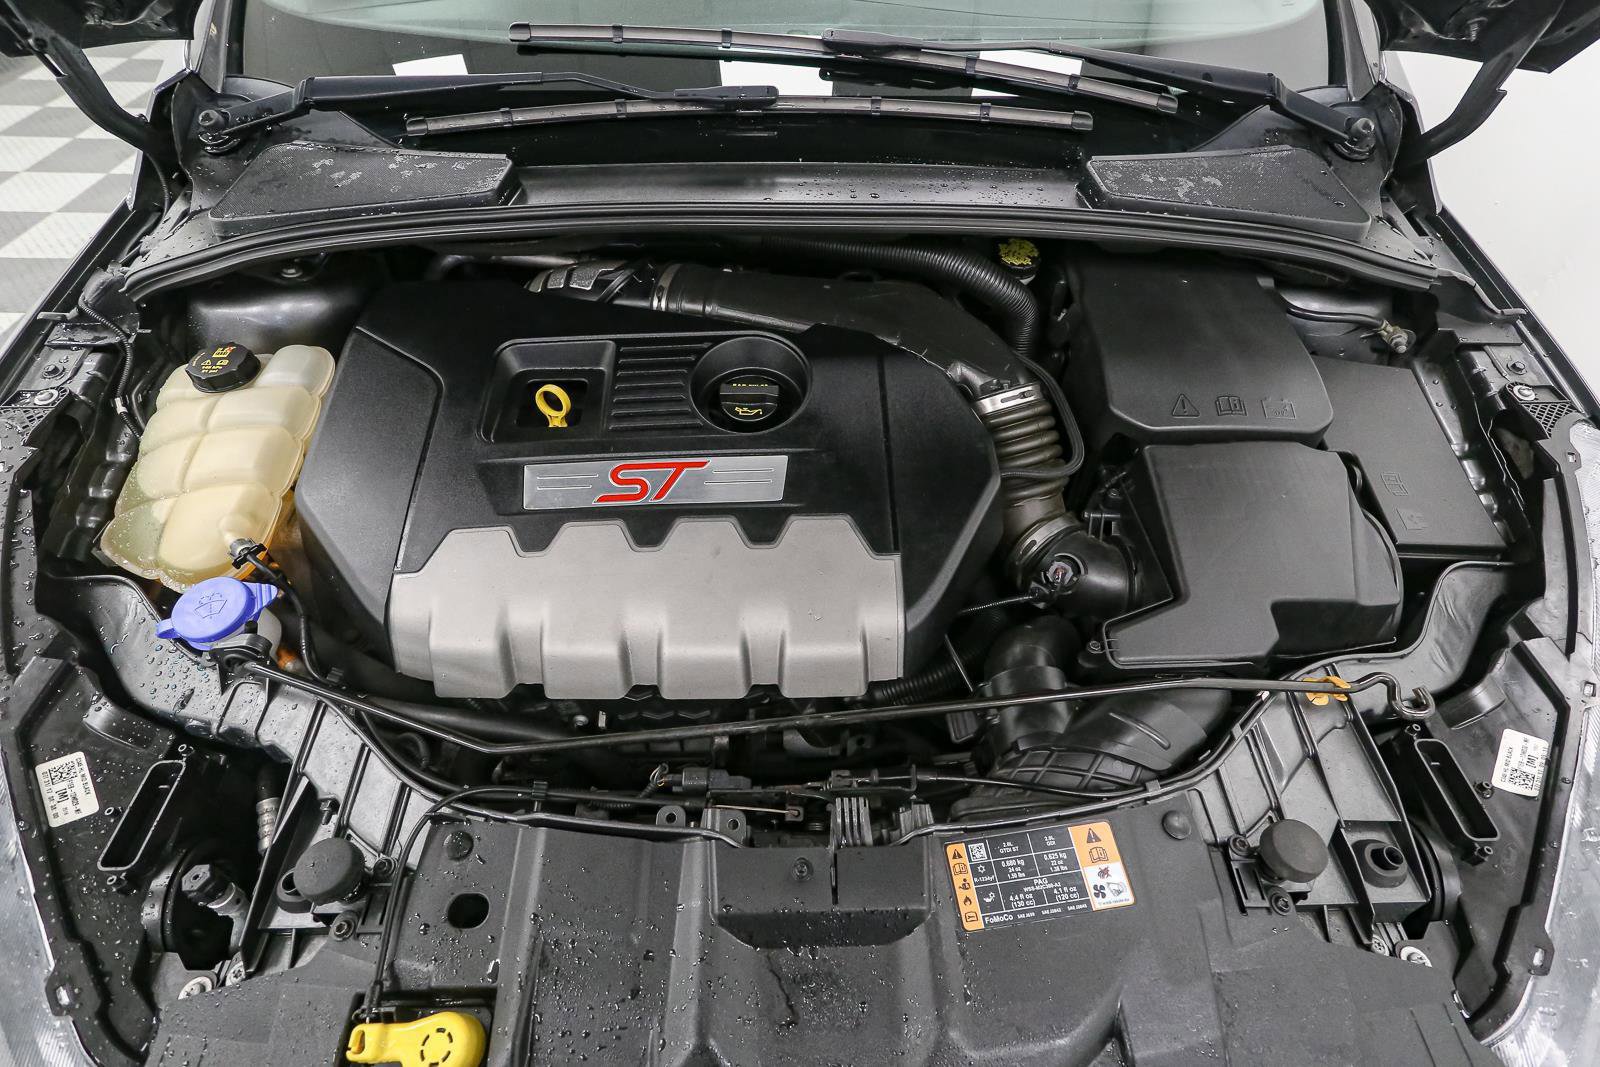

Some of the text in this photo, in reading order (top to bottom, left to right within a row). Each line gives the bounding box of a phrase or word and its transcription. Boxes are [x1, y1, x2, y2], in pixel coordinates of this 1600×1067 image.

[592, 457, 712, 504] ST
[1043, 852, 1059, 860] 0.625
[974, 875, 995, 883] R-1234yf
[1033, 878, 1048, 886] PAG
[1009, 894, 1019, 902] 4.4
[1055, 893, 1069, 902] (120
[1011, 901, 1024, 909] (130
[984, 914, 1013, 925] FoMoCo
